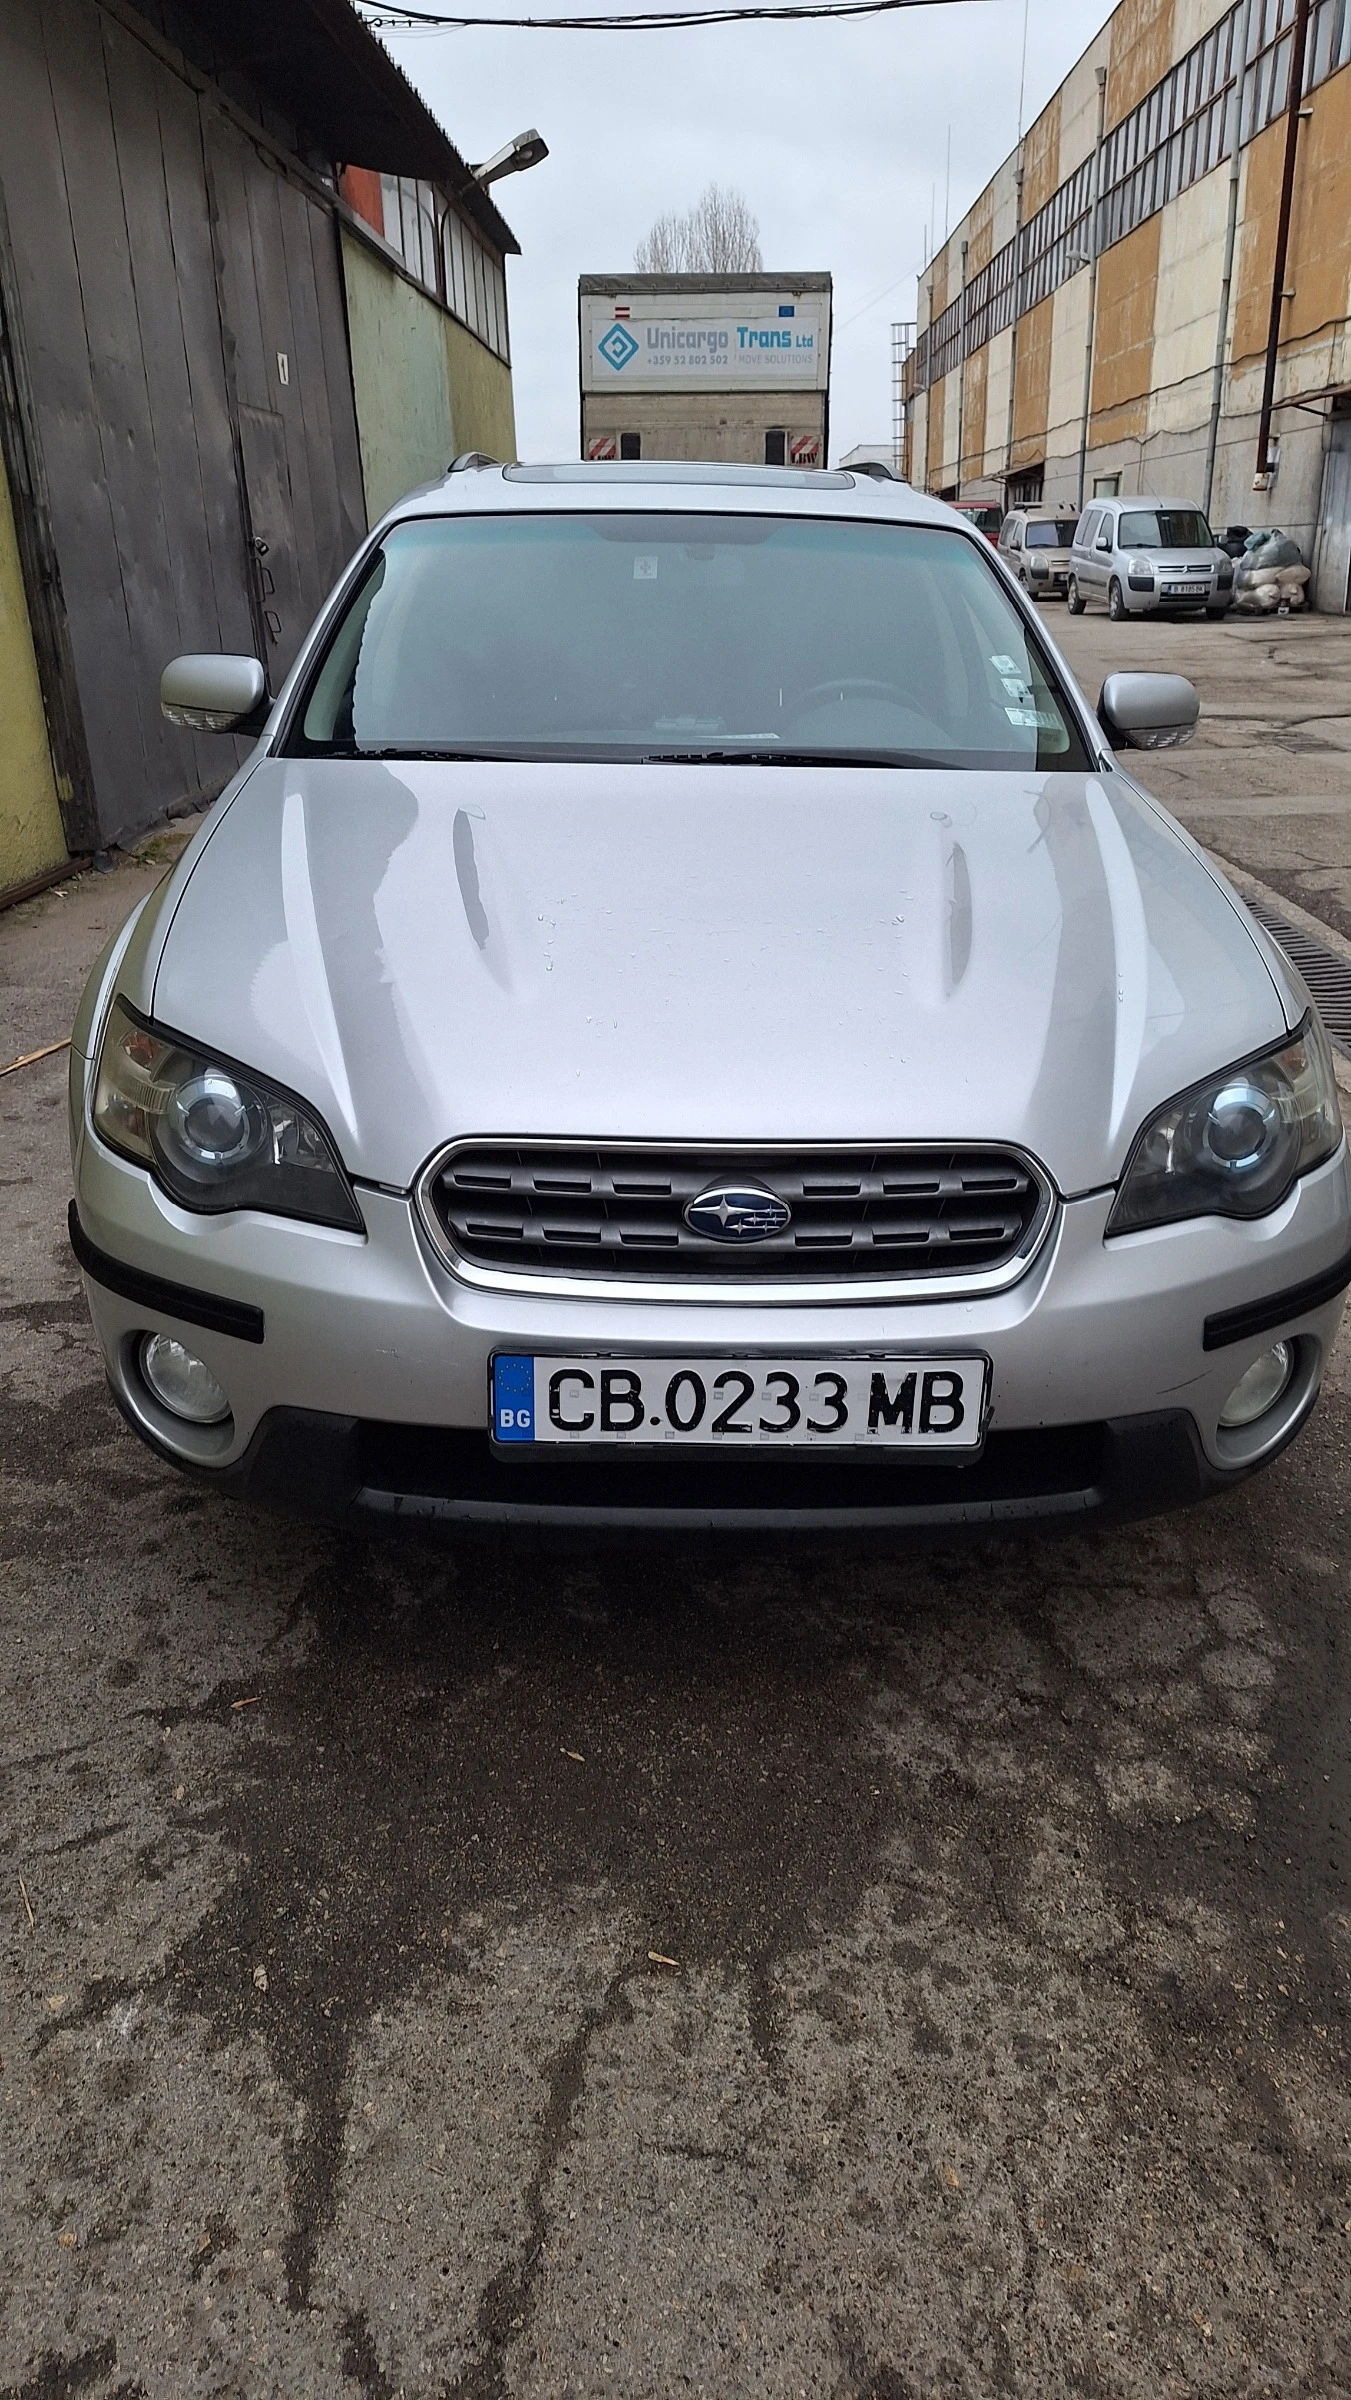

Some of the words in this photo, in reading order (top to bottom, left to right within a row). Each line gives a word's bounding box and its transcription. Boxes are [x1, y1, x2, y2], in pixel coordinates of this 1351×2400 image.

[647, 326, 729, 353] Unicargo
[736, 326, 792, 348] Trans
[796, 335, 813, 348] Ltd
[647, 355, 671, 365] +359
[674, 355, 686, 365] 52
[688, 355, 707, 365] 802
[710, 355, 728, 365] 502
[738, 354, 762, 364] MOVE
[765, 354, 813, 364] SOLUTIONS
[549, 1368, 645, 1432] CB
[665, 1370, 849, 1433] 0233
[866, 1371, 965, 1434] MB
[500, 1409, 531, 1428] BG
